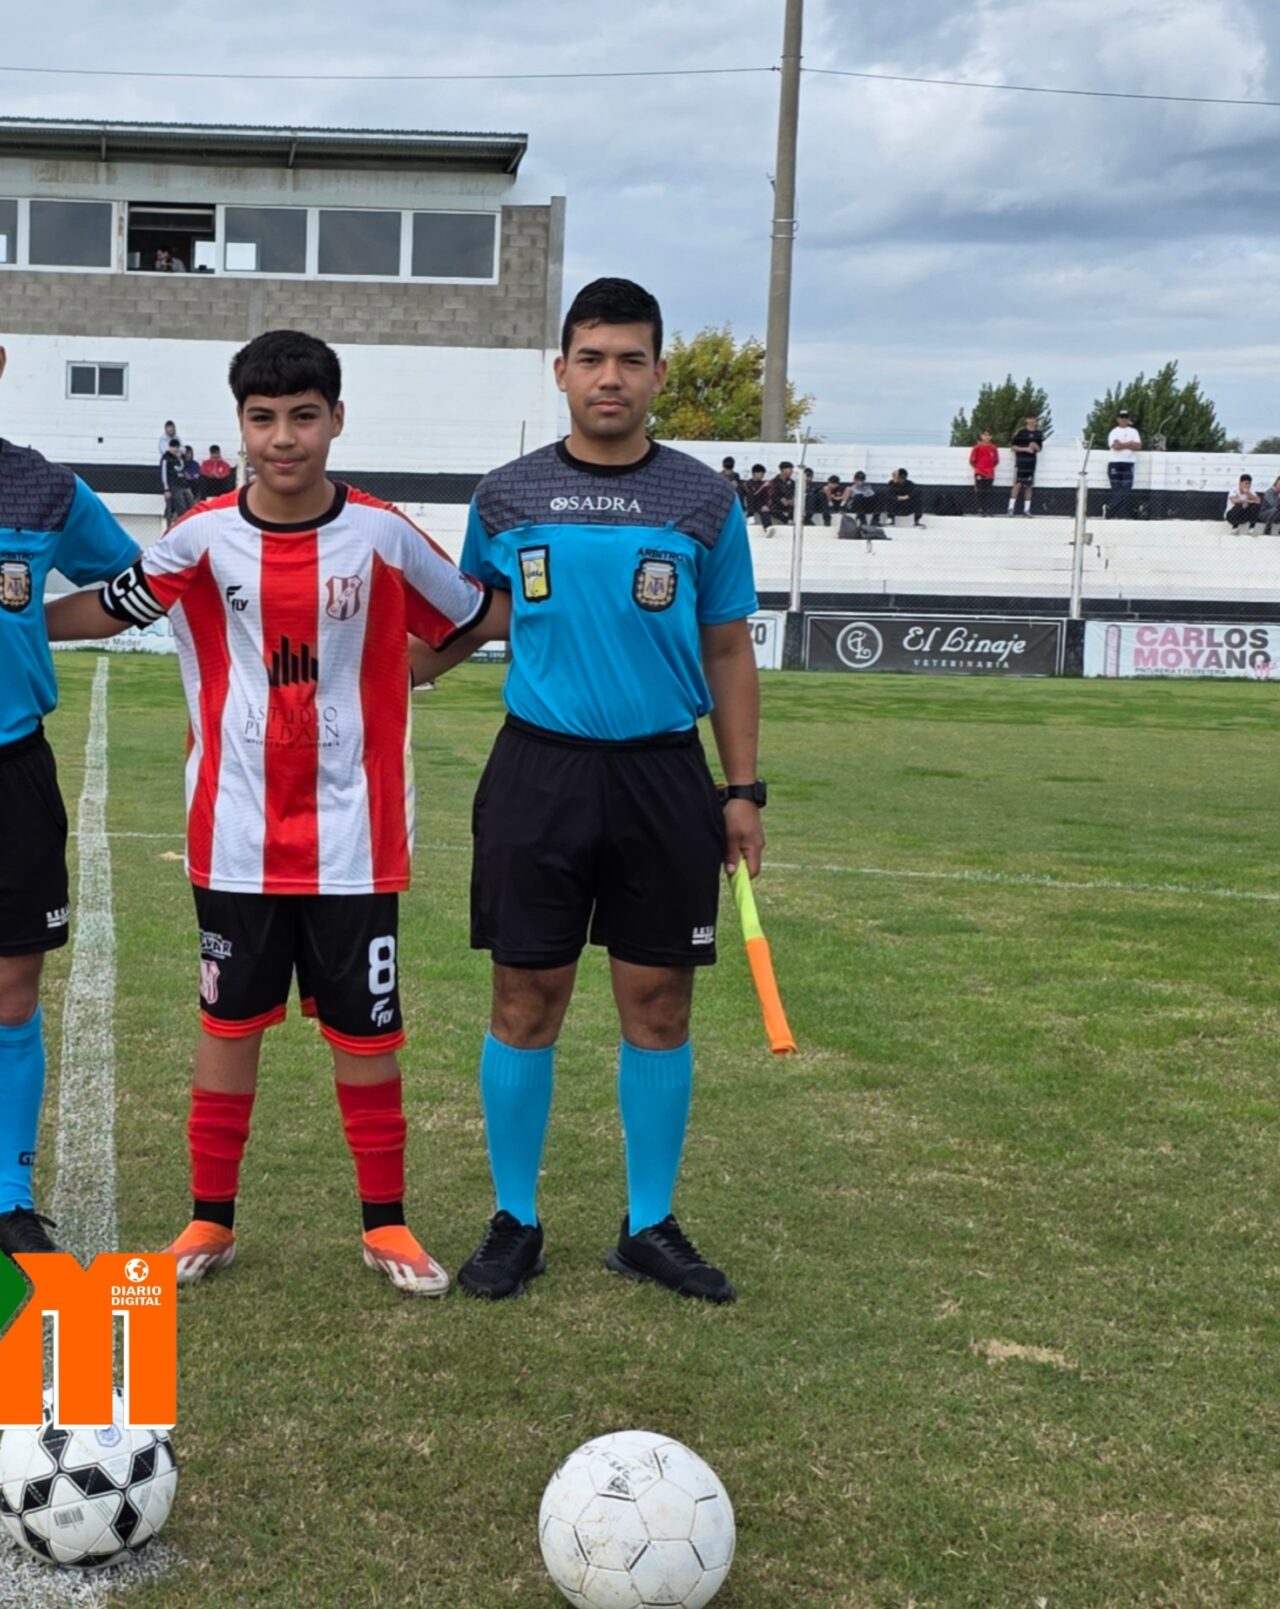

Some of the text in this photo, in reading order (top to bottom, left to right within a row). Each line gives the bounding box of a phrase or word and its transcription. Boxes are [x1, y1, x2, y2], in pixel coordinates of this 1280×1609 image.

[568, 495, 642, 514] SADRA
[902, 626, 941, 652] El
[1135, 625, 1270, 650] CARLOS
[1133, 648, 1272, 670] MOYANO
[246, 703, 338, 725] ESTUDIO
[369, 934, 395, 995] 8
